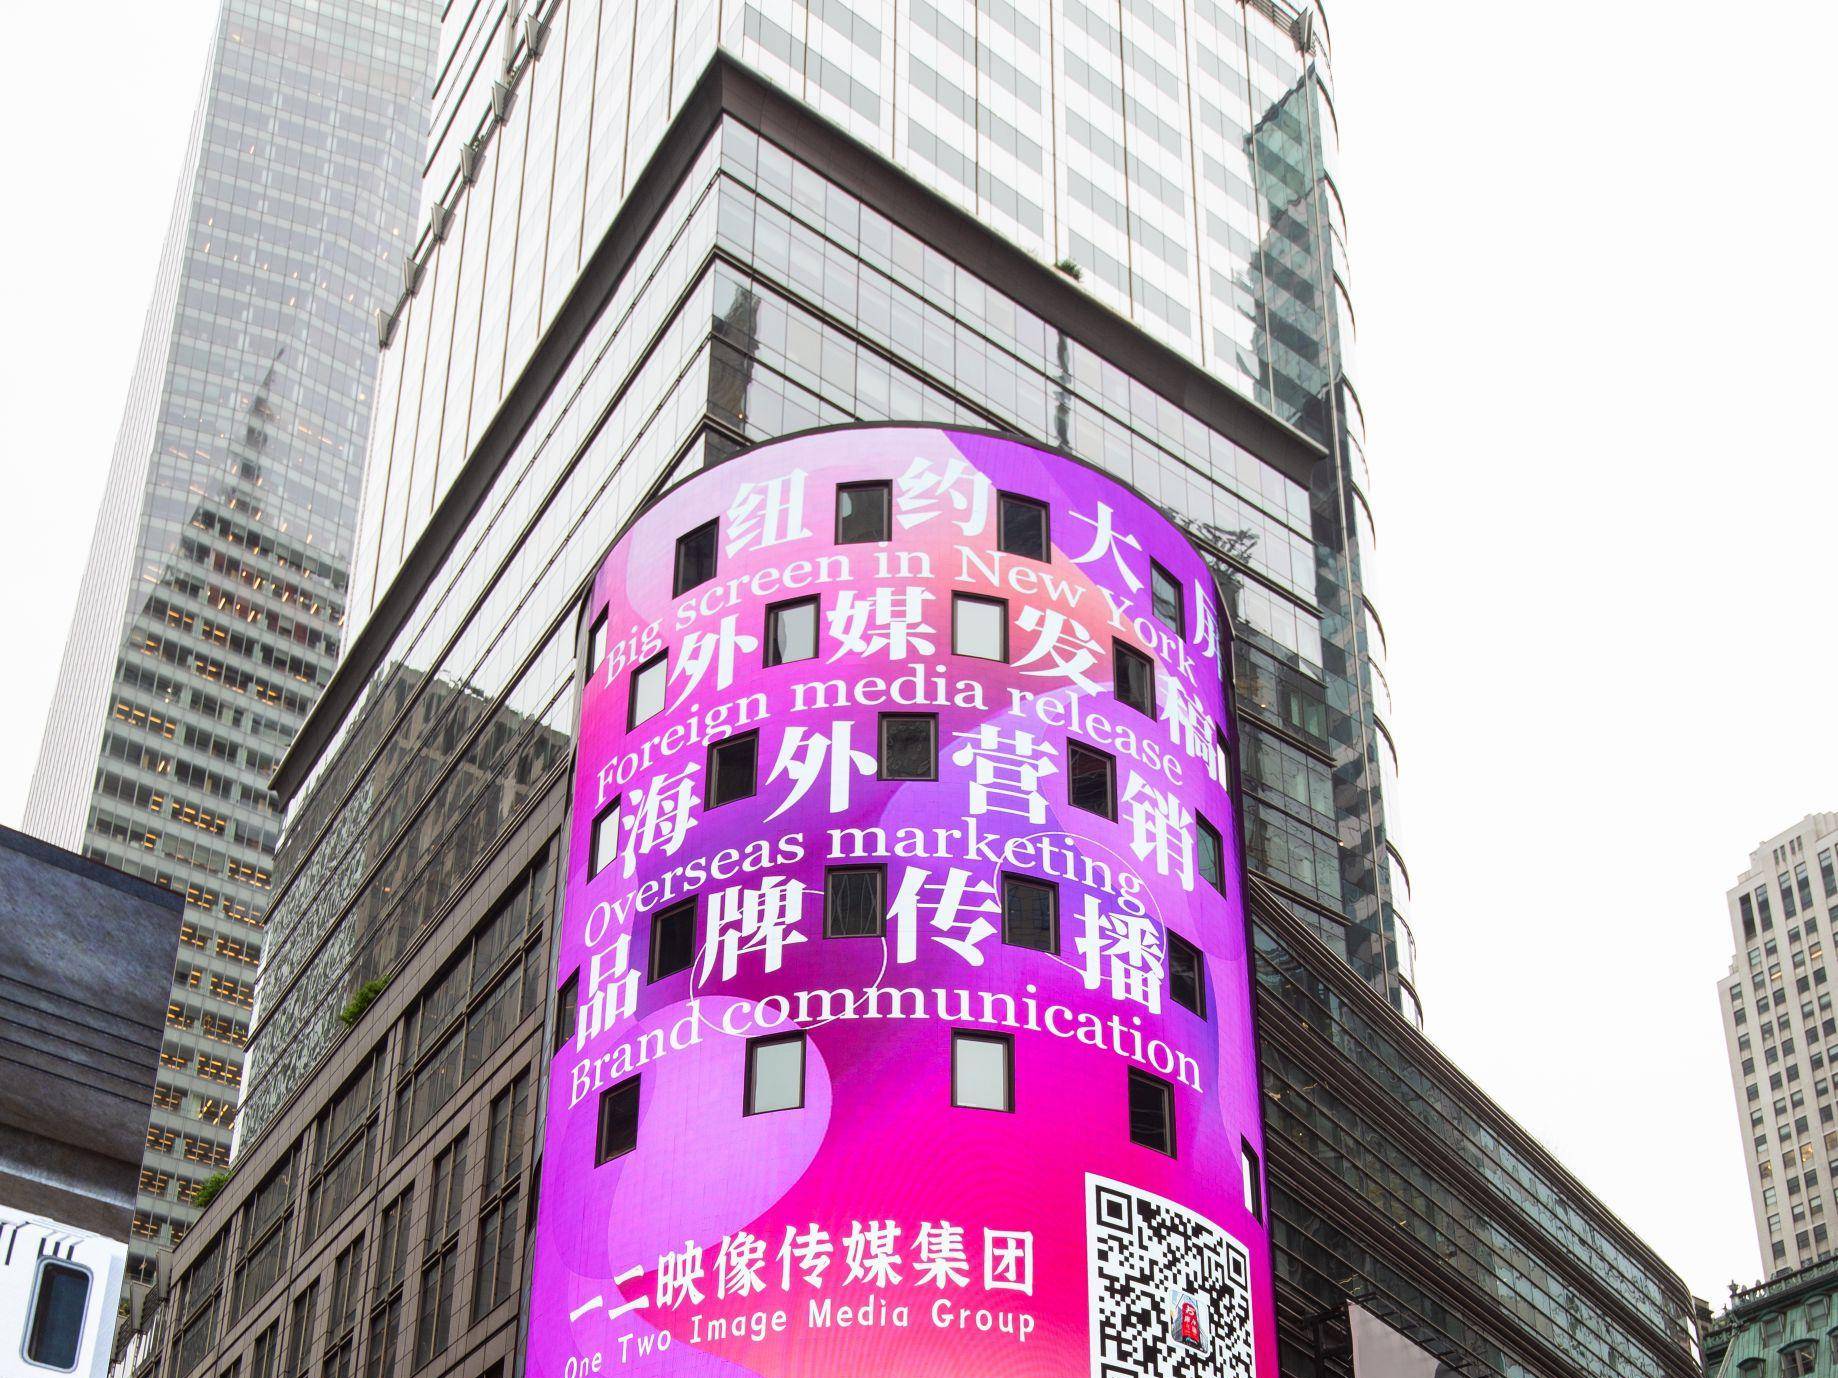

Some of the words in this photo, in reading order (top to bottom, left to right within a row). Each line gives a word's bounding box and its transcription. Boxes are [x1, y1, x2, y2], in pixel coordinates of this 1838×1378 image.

[604, 618, 663, 688] Big
[675, 553, 850, 631] screen
[877, 542, 933, 579] in
[955, 544, 1086, 609] New
[1097, 585, 1198, 687] York
[595, 692, 771, 809] Foreign
[790, 665, 985, 709] media
[1007, 686, 1183, 785] release
[620, 721, 1197, 892] 海外营销
[584, 829, 805, 947] Overseas
[828, 818, 1144, 919] marketing
[575, 866, 1166, 1051] 品牌传播
[569, 999, 701, 1111] Brand
[722, 985, 1205, 1094] communication
[569, 1220, 1034, 1321] 一二映像传媒集团
[617, 1330, 672, 1363] Two
[689, 1307, 787, 1344] Image
[808, 1295, 909, 1328] Media
[931, 1299, 1036, 1341] Group
